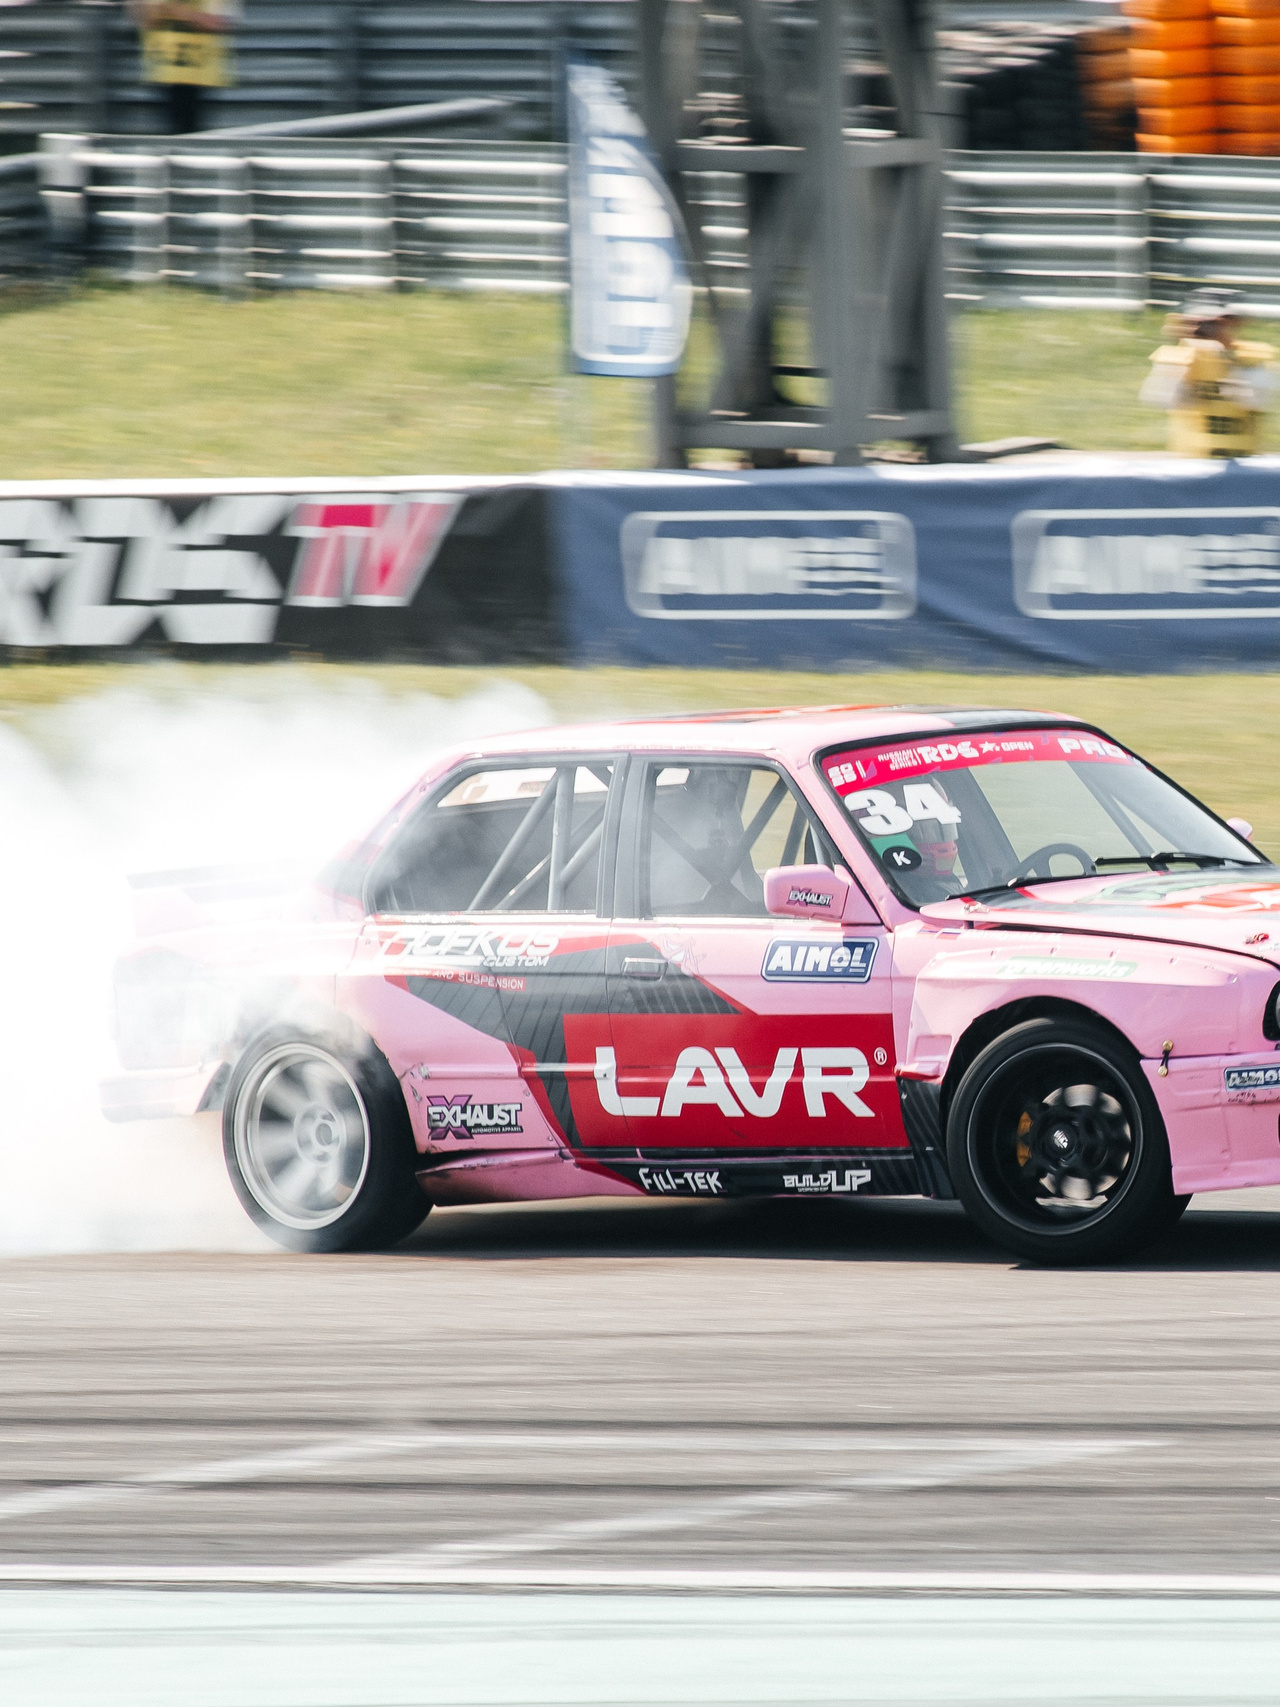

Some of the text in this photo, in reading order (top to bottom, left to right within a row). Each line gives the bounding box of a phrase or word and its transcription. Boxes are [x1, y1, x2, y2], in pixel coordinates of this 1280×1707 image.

[1057, 738, 1126, 758] PRO
[844, 783, 962, 835] 34
[892, 851, 911, 866] K
[788, 888, 832, 906] EXHAUST
[482, 956, 549, 967] CUSTOM
[767, 945, 867, 972] AIMOL
[458, 973, 524, 990] SUSPENSION
[594, 1046, 876, 1118] LAVR
[428, 1101, 521, 1129] EXHAUST
[638, 1168, 723, 1193] FILI-TEK
